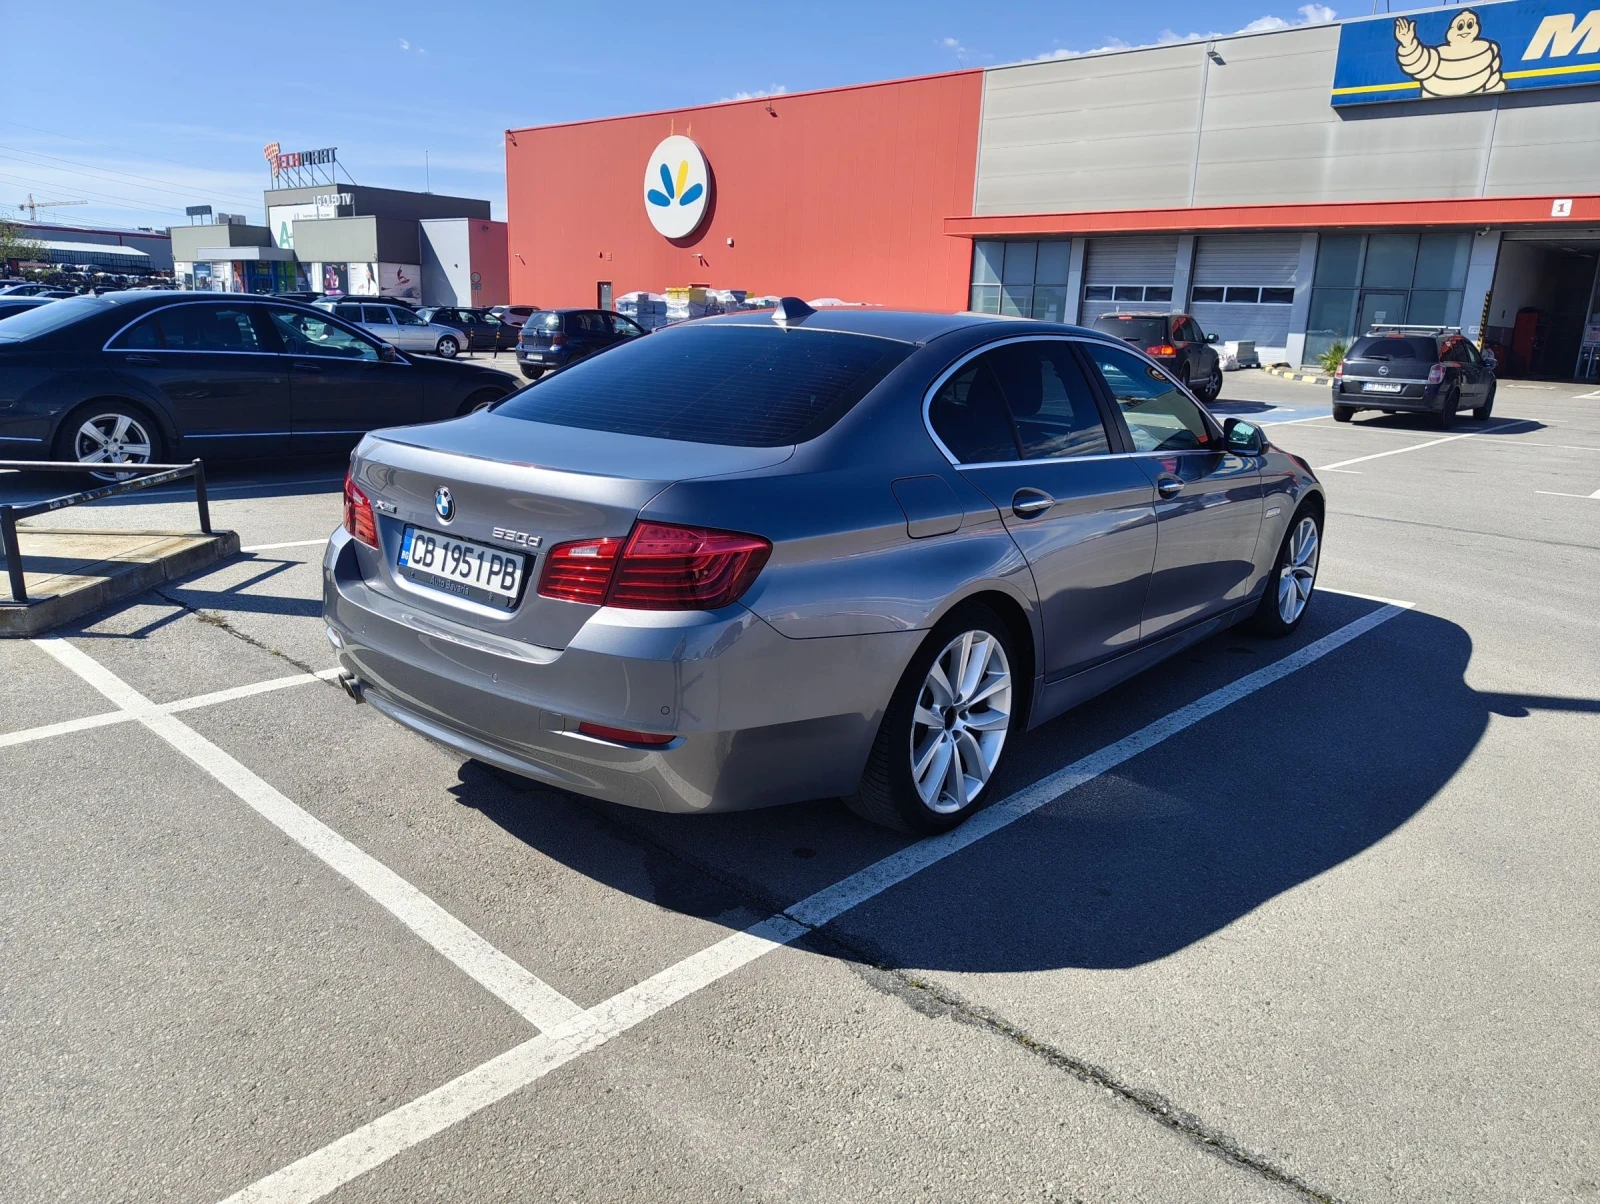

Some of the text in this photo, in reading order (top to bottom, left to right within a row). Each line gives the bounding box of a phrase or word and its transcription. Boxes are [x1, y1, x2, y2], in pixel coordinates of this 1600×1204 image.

[322, 194, 340, 206] OLED
[341, 193, 351, 205] TV
[1557, 203, 1565, 213] 1
[401, 550, 409, 560] BG
[412, 534, 517, 591] CB 1951 PB
[429, 575, 469, 595] Auto Bavaria
